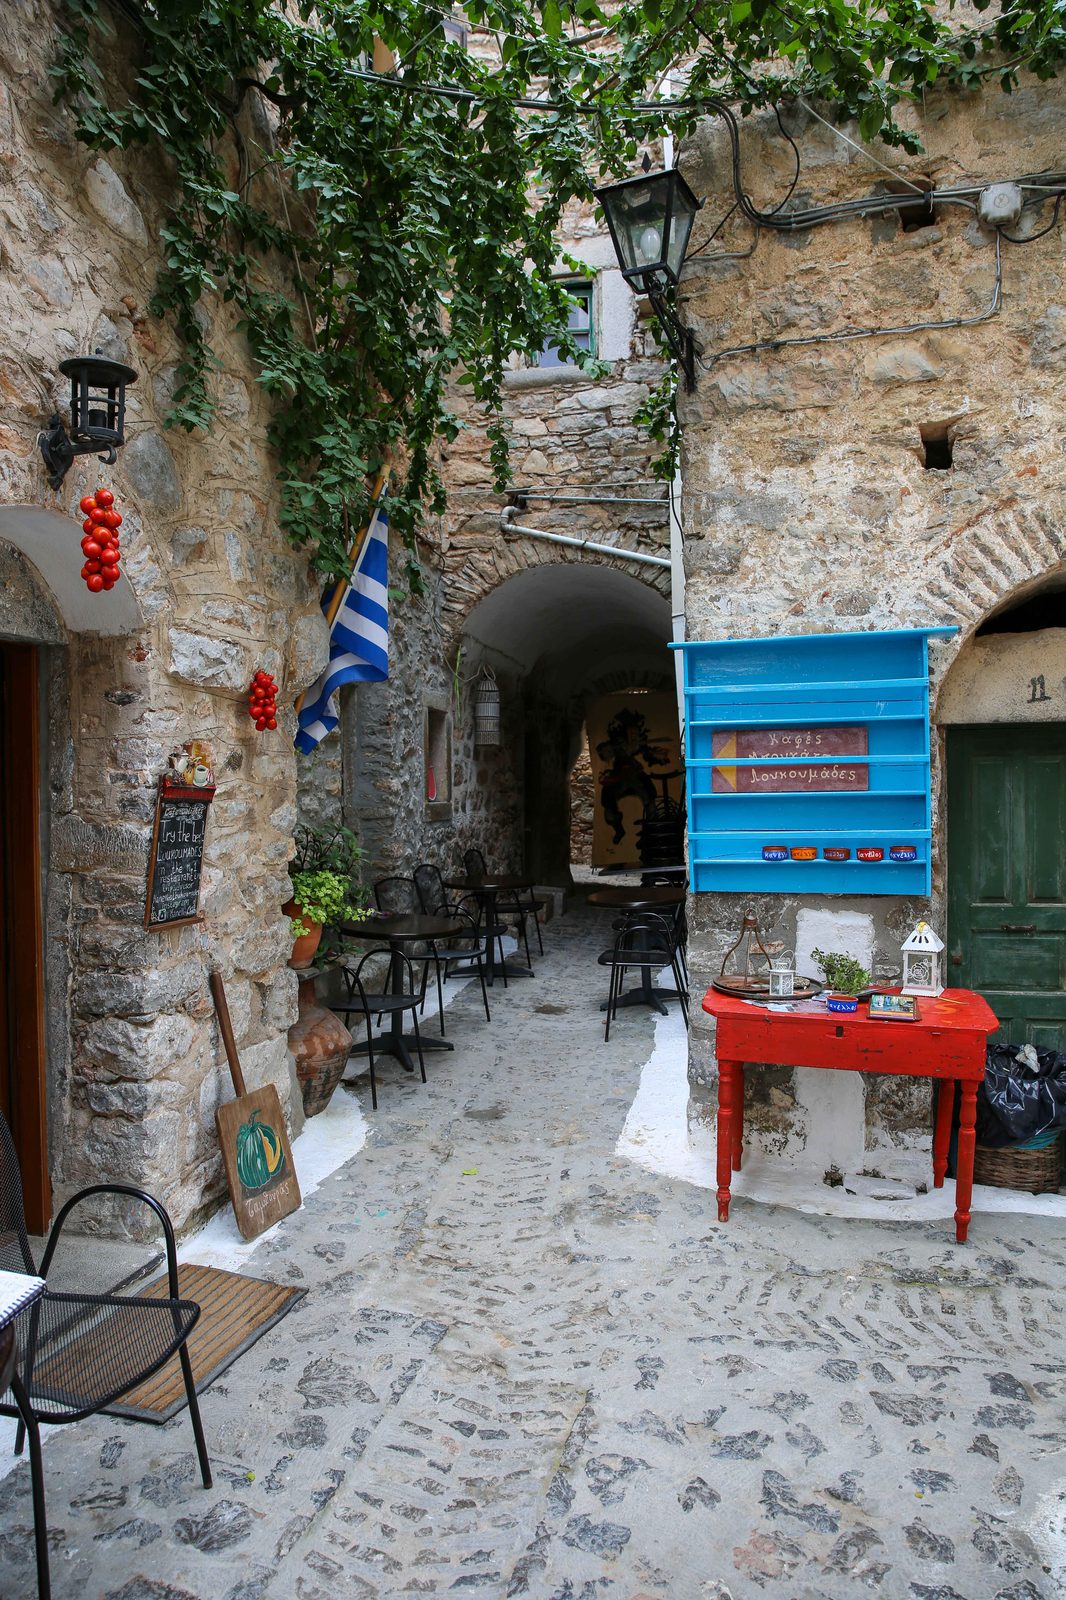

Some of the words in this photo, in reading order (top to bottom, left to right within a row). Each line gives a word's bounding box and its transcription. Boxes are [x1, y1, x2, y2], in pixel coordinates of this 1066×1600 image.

[769, 731, 823, 749] Καφές
[750, 764, 856, 783] Λουκουμάδες
[160, 819, 176, 842] Try
[178, 818, 190, 842] the
